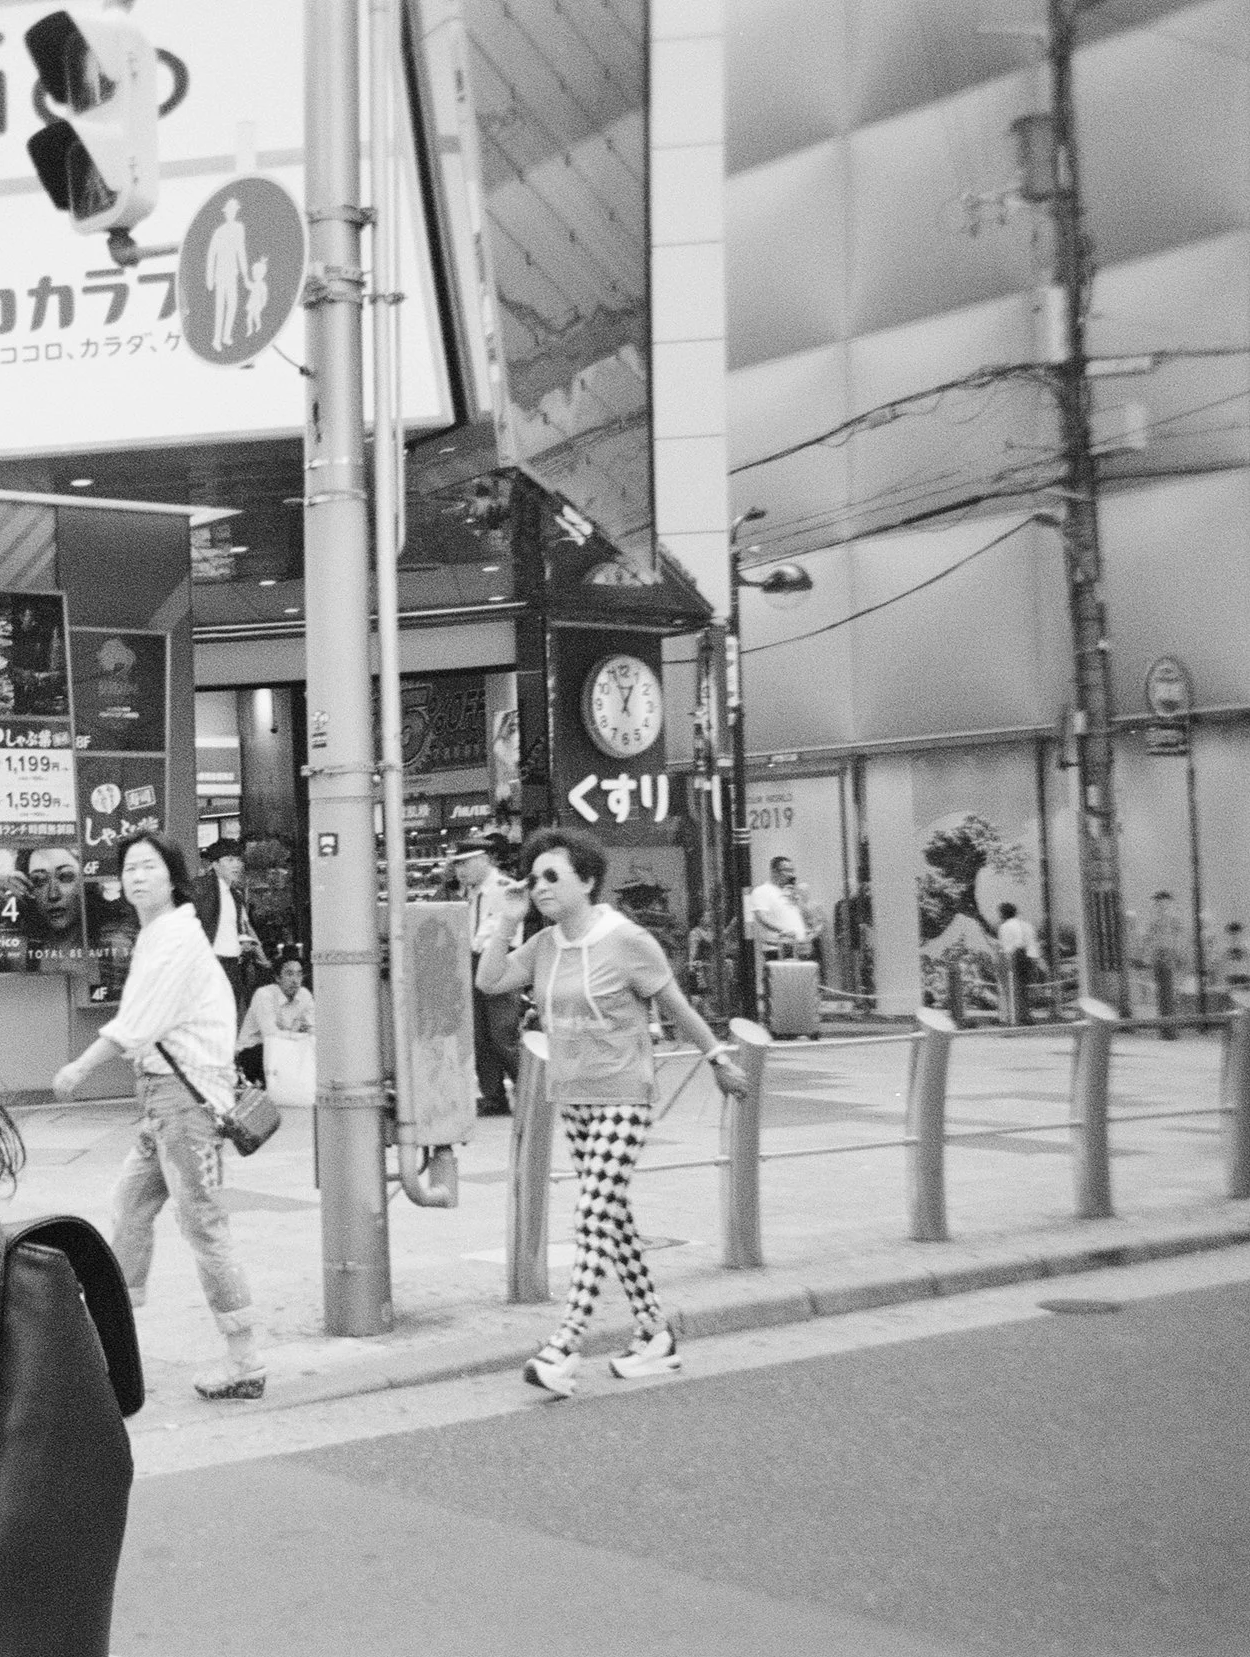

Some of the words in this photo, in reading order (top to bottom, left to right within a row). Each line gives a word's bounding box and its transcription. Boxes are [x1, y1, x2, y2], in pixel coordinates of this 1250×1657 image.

[568, 773, 669, 823] くすり
[749, 806, 793, 830] 2019
[1, 896, 20, 923] 4
